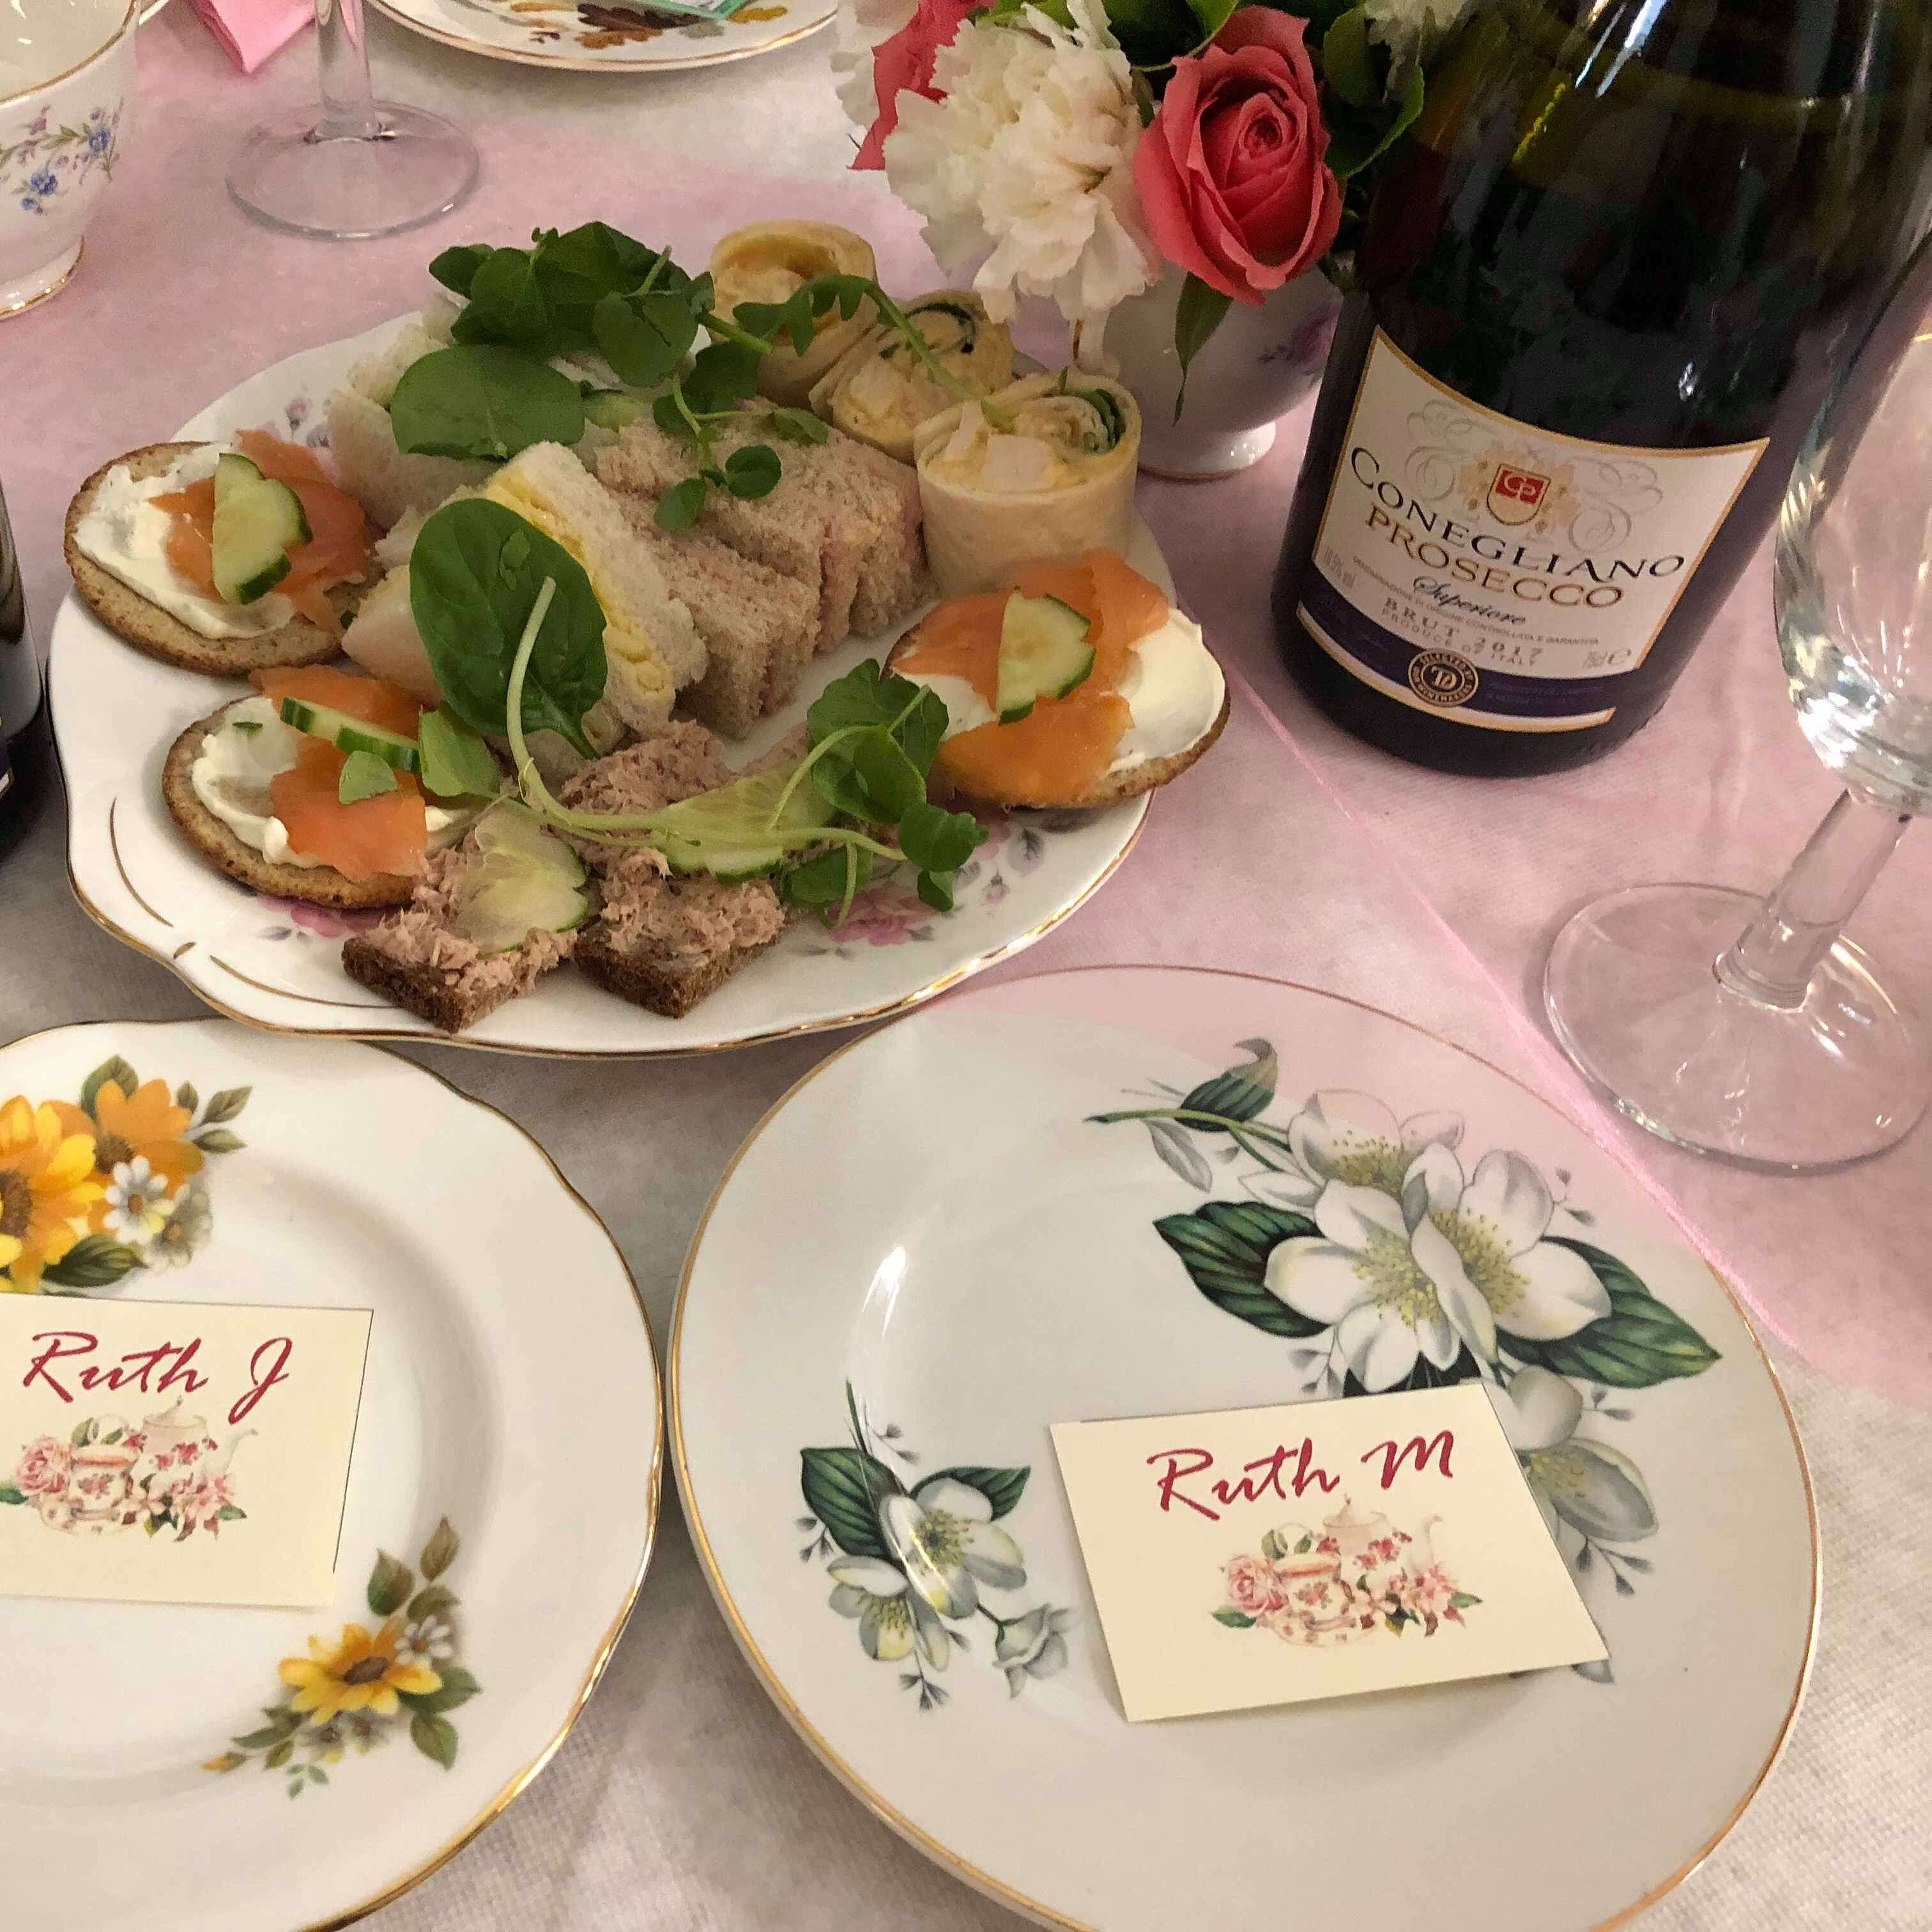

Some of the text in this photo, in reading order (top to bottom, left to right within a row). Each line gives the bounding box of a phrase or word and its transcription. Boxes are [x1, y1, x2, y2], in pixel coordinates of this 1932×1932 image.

[1351, 447, 1684, 583] CONEGLIANO
[1365, 502, 1623, 608] PROSECCO
[1383, 596, 1460, 637] BRUT
[22, 1331, 293, 1425] Ruth J
[1146, 1429, 1455, 1522] Ruth M
